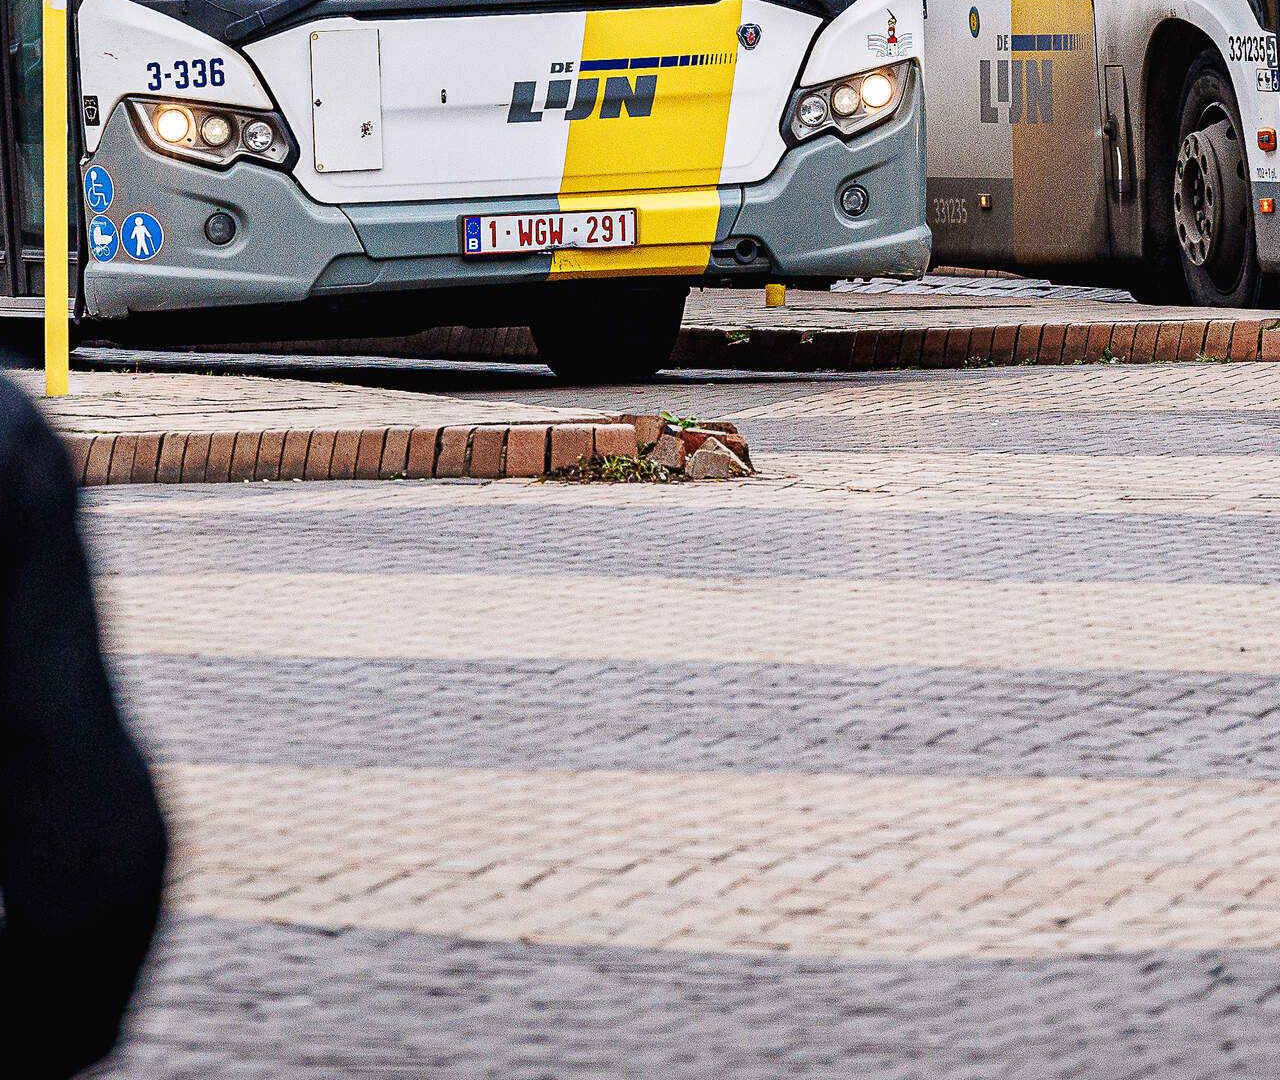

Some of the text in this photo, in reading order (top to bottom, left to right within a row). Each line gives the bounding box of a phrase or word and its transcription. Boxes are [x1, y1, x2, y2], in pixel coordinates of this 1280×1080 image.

[996, 34, 1009, 52] DE
[1229, 35, 1266, 62] 331235
[146, 57, 225, 91] 3-336
[550, 61, 574, 74] DE
[507, 75, 658, 123] LIJN
[980, 59, 1054, 124] LIJN
[933, 198, 968, 224] 331235
[468, 238, 479, 250] B
